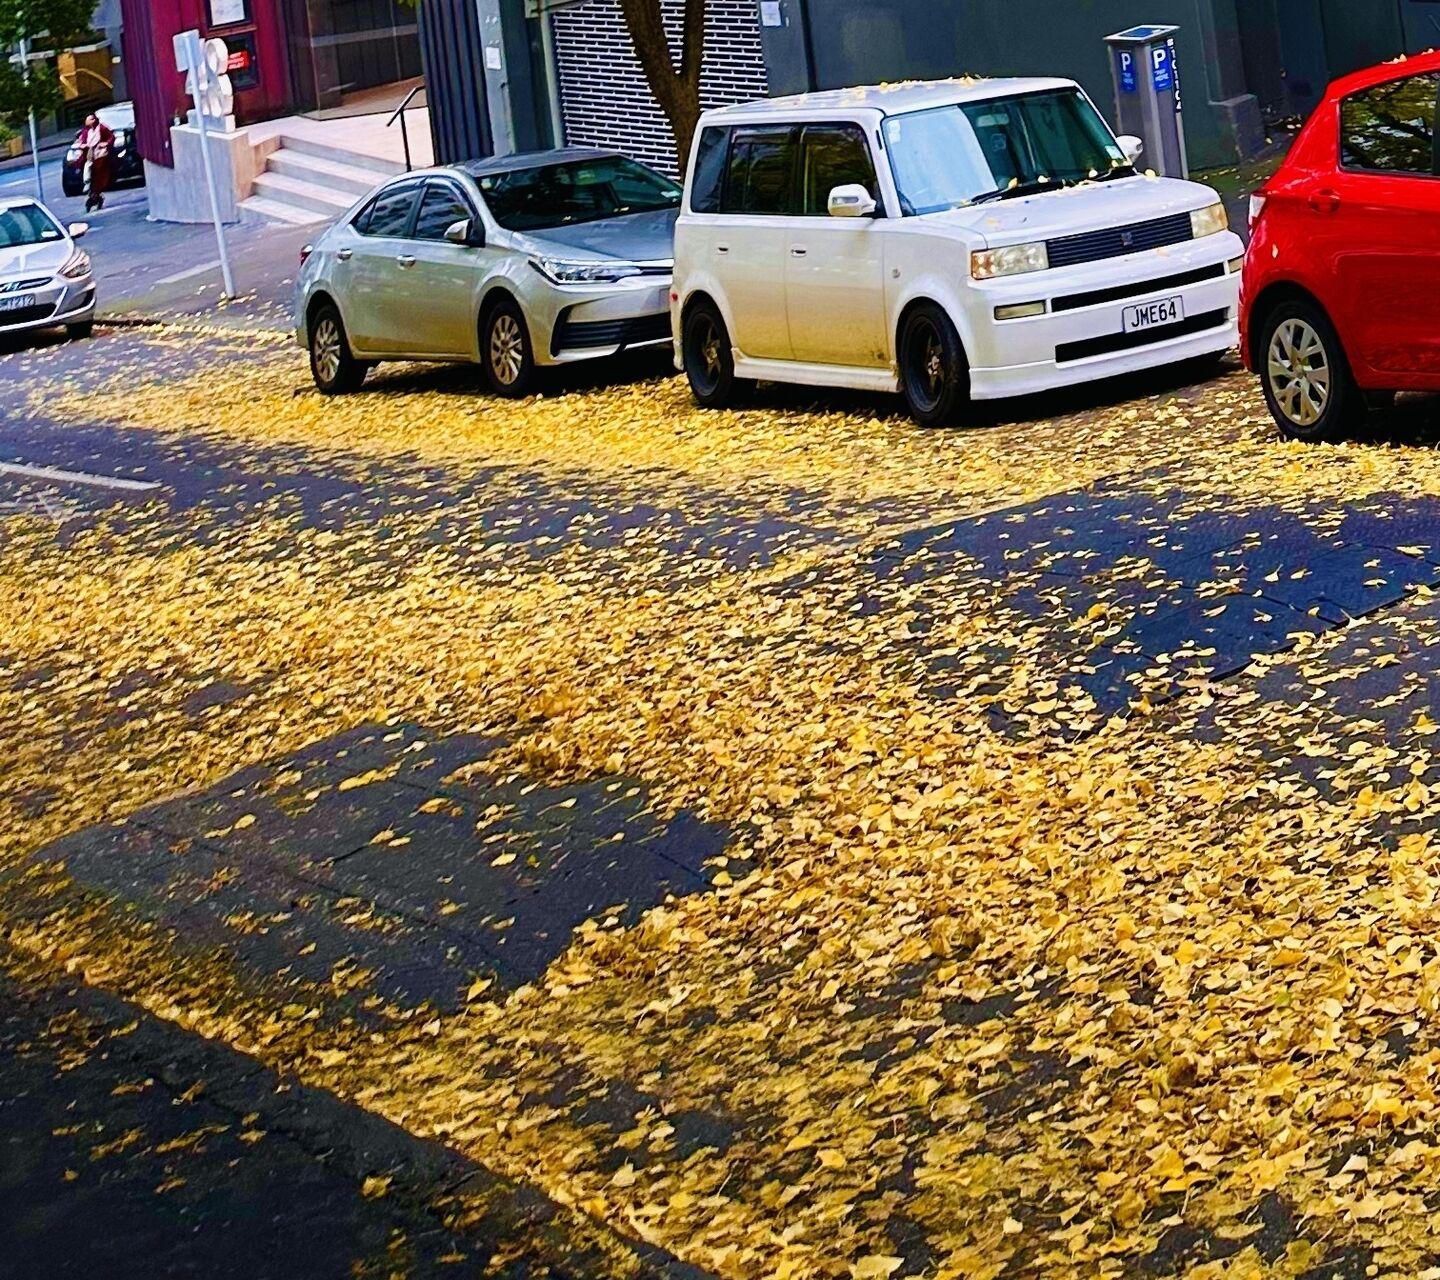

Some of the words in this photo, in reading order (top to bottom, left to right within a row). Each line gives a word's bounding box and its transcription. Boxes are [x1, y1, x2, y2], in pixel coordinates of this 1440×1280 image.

[1121, 52, 1131, 71] P
[1153, 49, 1166, 69] P
[1131, 302, 1176, 327] JME64
